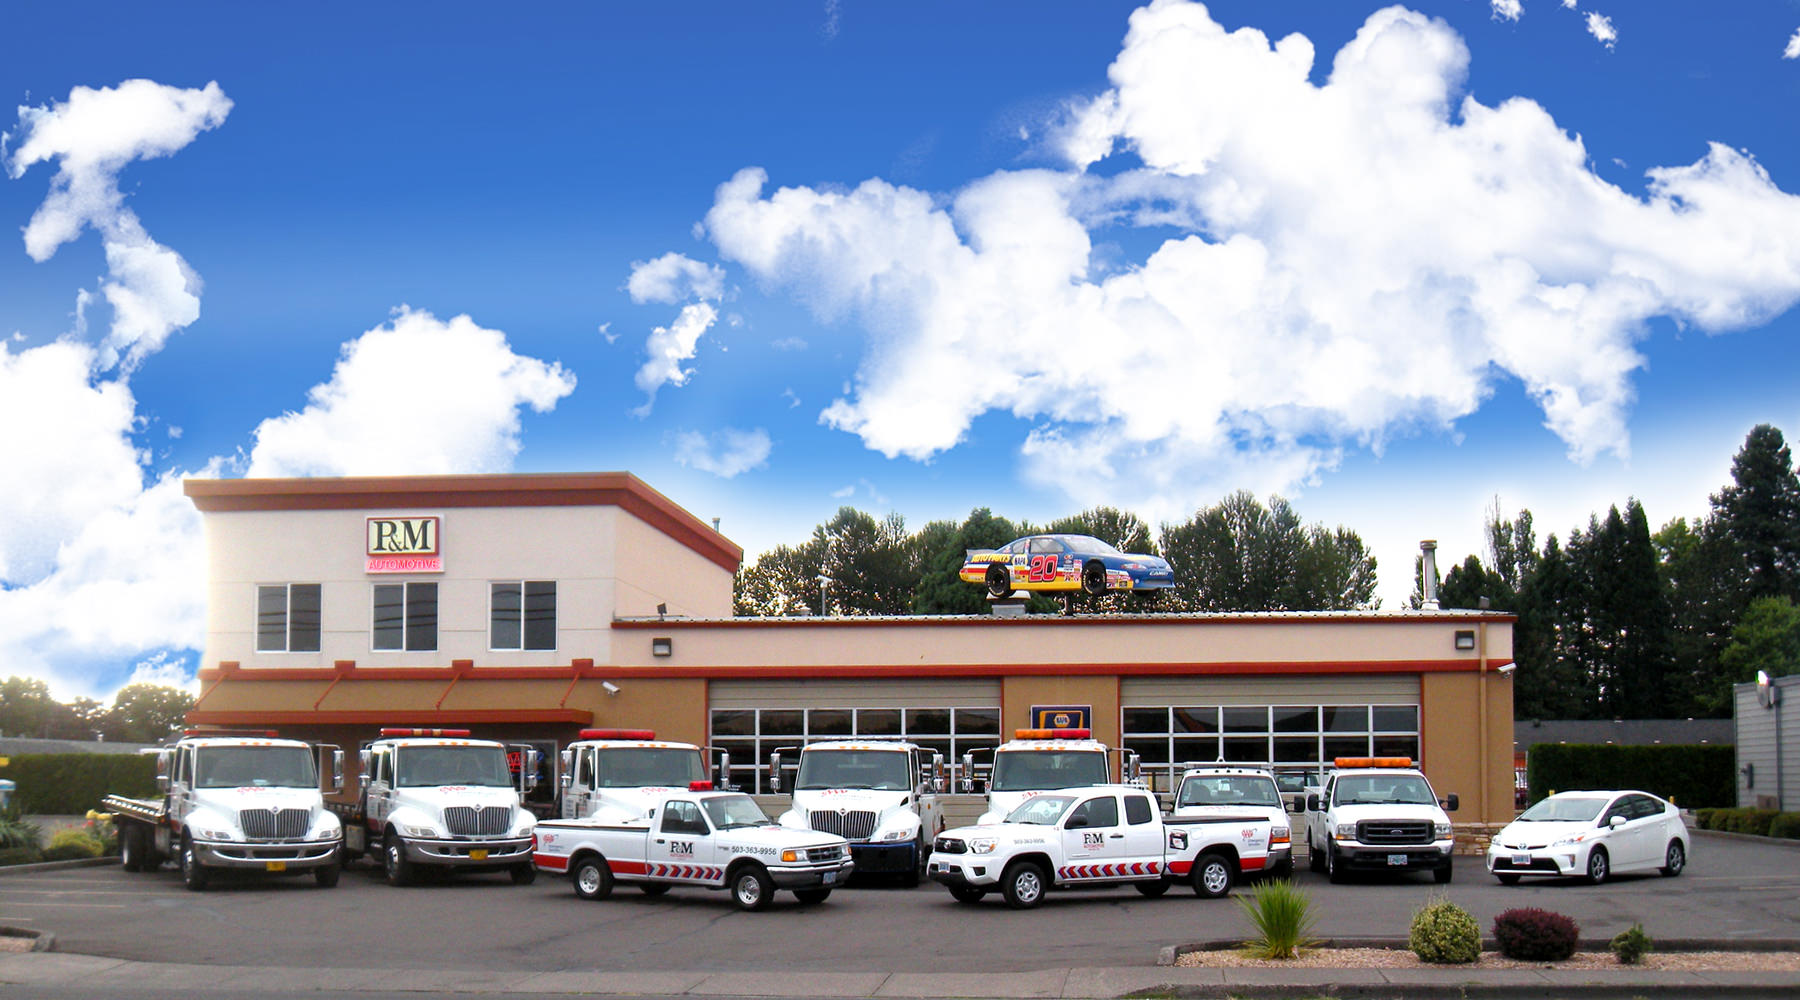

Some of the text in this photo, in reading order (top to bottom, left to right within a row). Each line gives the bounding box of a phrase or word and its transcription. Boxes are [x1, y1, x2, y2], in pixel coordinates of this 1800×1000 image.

[373, 519, 431, 552] R&M
[368, 559, 440, 569] AUTOMOTIVE
[1029, 554, 1058, 582] 20
[671, 841, 694, 854] R&M
[731, 845, 777, 855] 503-363-9956
